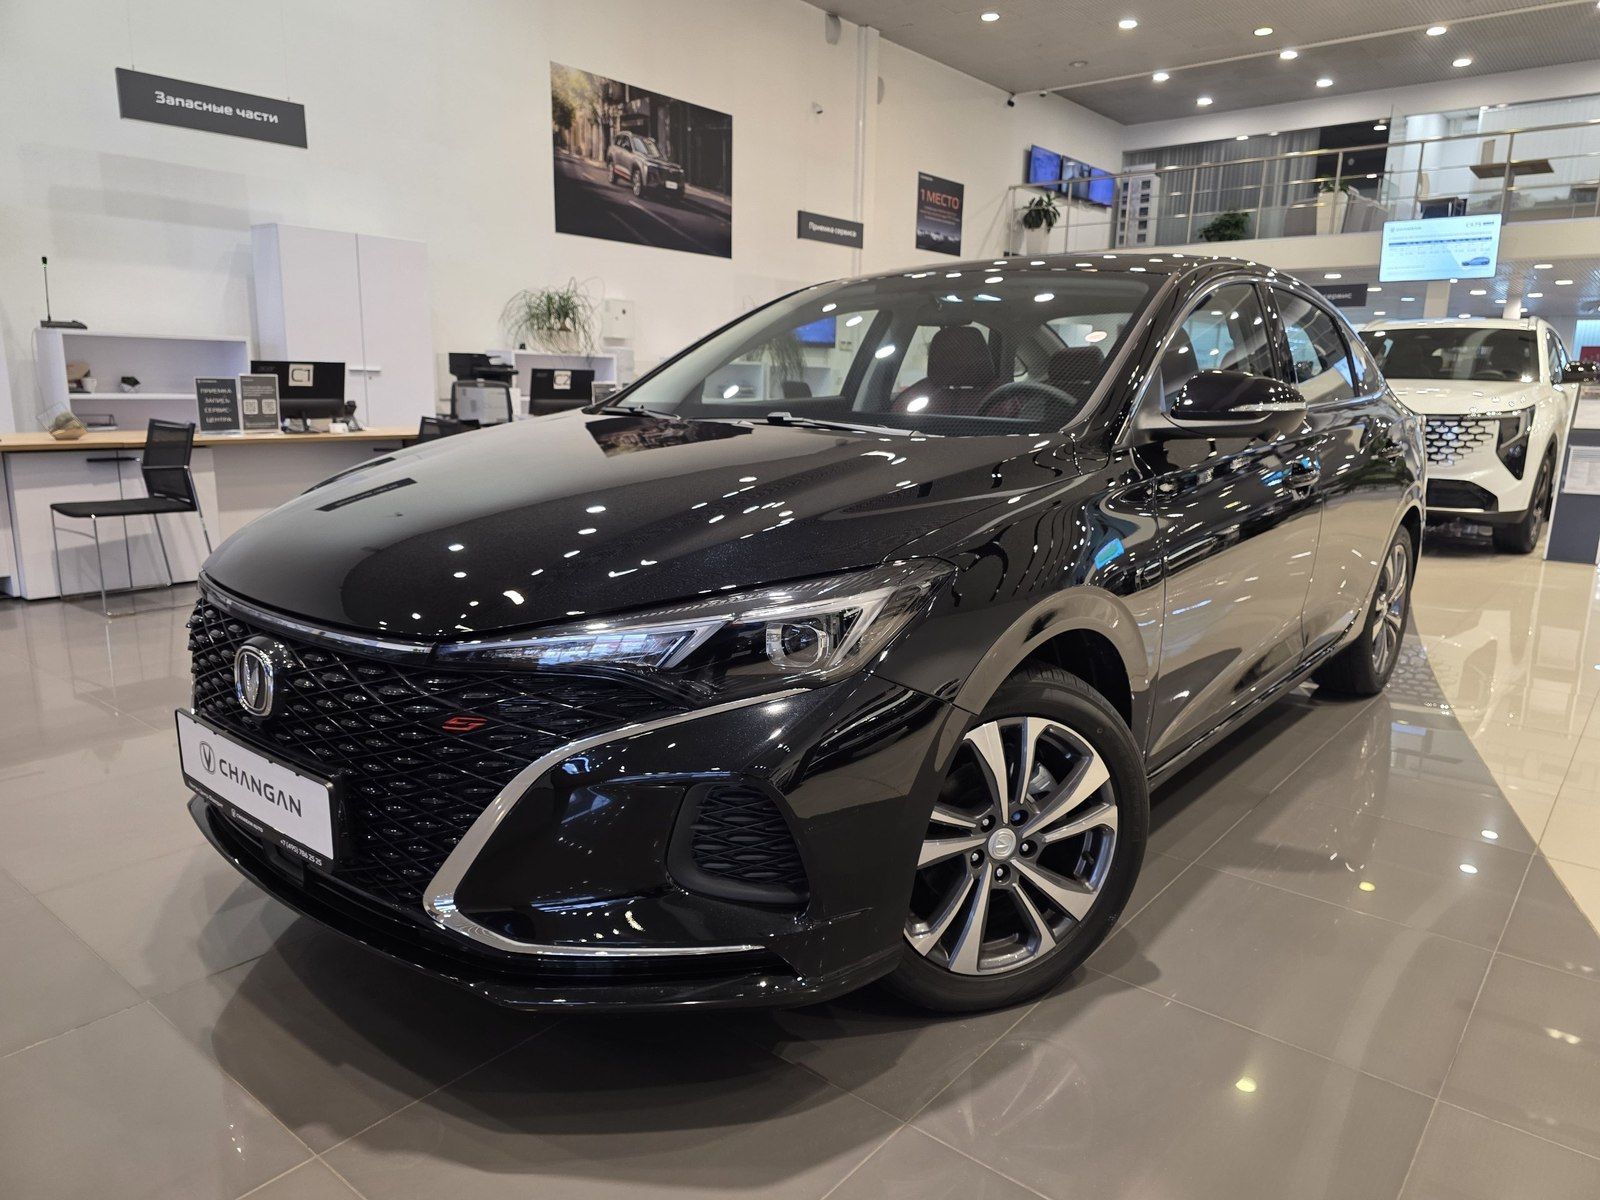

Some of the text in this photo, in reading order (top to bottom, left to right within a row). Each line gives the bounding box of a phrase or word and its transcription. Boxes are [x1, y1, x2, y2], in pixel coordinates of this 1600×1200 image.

[154, 90, 279, 123] Запасные части
[920, 188, 960, 209] 1 МЕСТО
[291, 368, 311, 383] C1
[219, 759, 302, 817] CHANGAN
